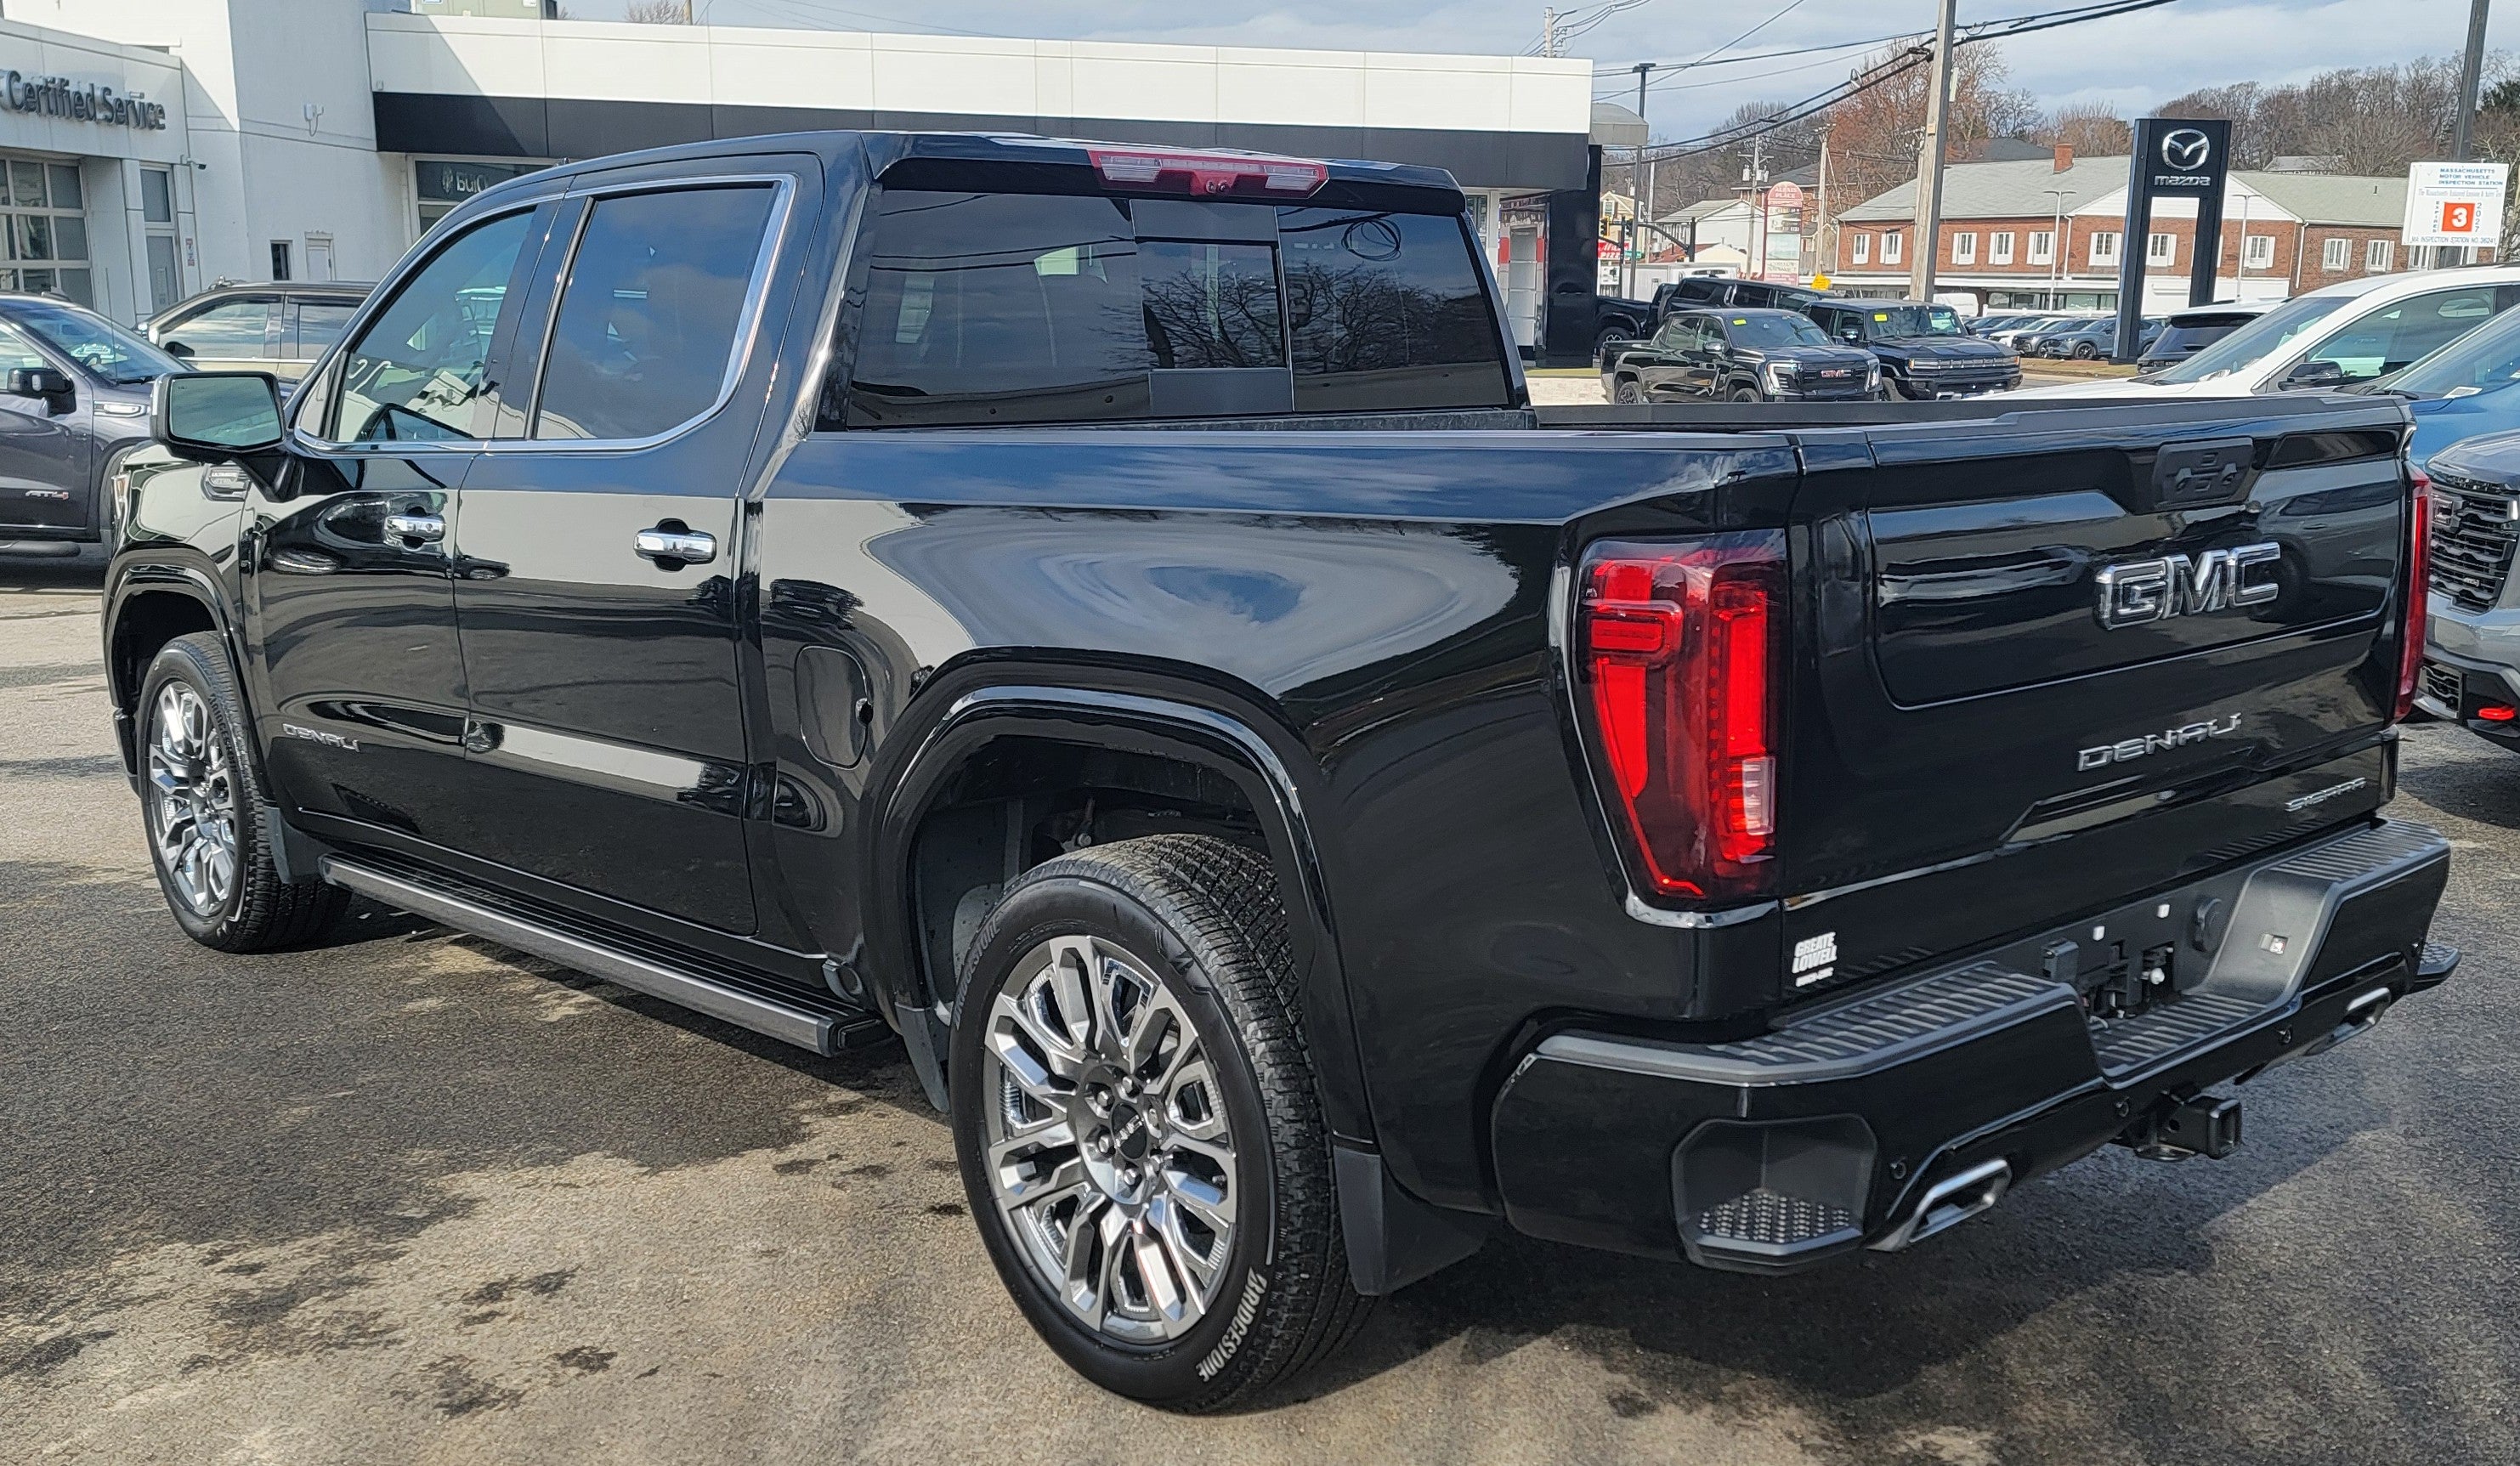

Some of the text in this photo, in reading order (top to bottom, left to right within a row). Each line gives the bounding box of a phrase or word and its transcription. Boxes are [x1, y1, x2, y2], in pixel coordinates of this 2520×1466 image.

[7, 71, 166, 130] Certified Service
[456, 171, 489, 193] BUIC
[2451, 207, 2468, 228] 3
[2092, 541, 2281, 631] GMC
[282, 723, 360, 753] DENALI
[2077, 712, 2242, 771] DENALI
[1792, 945, 1837, 973] LOWELL
[1195, 1266, 1267, 1382] BRIDGESTONE
